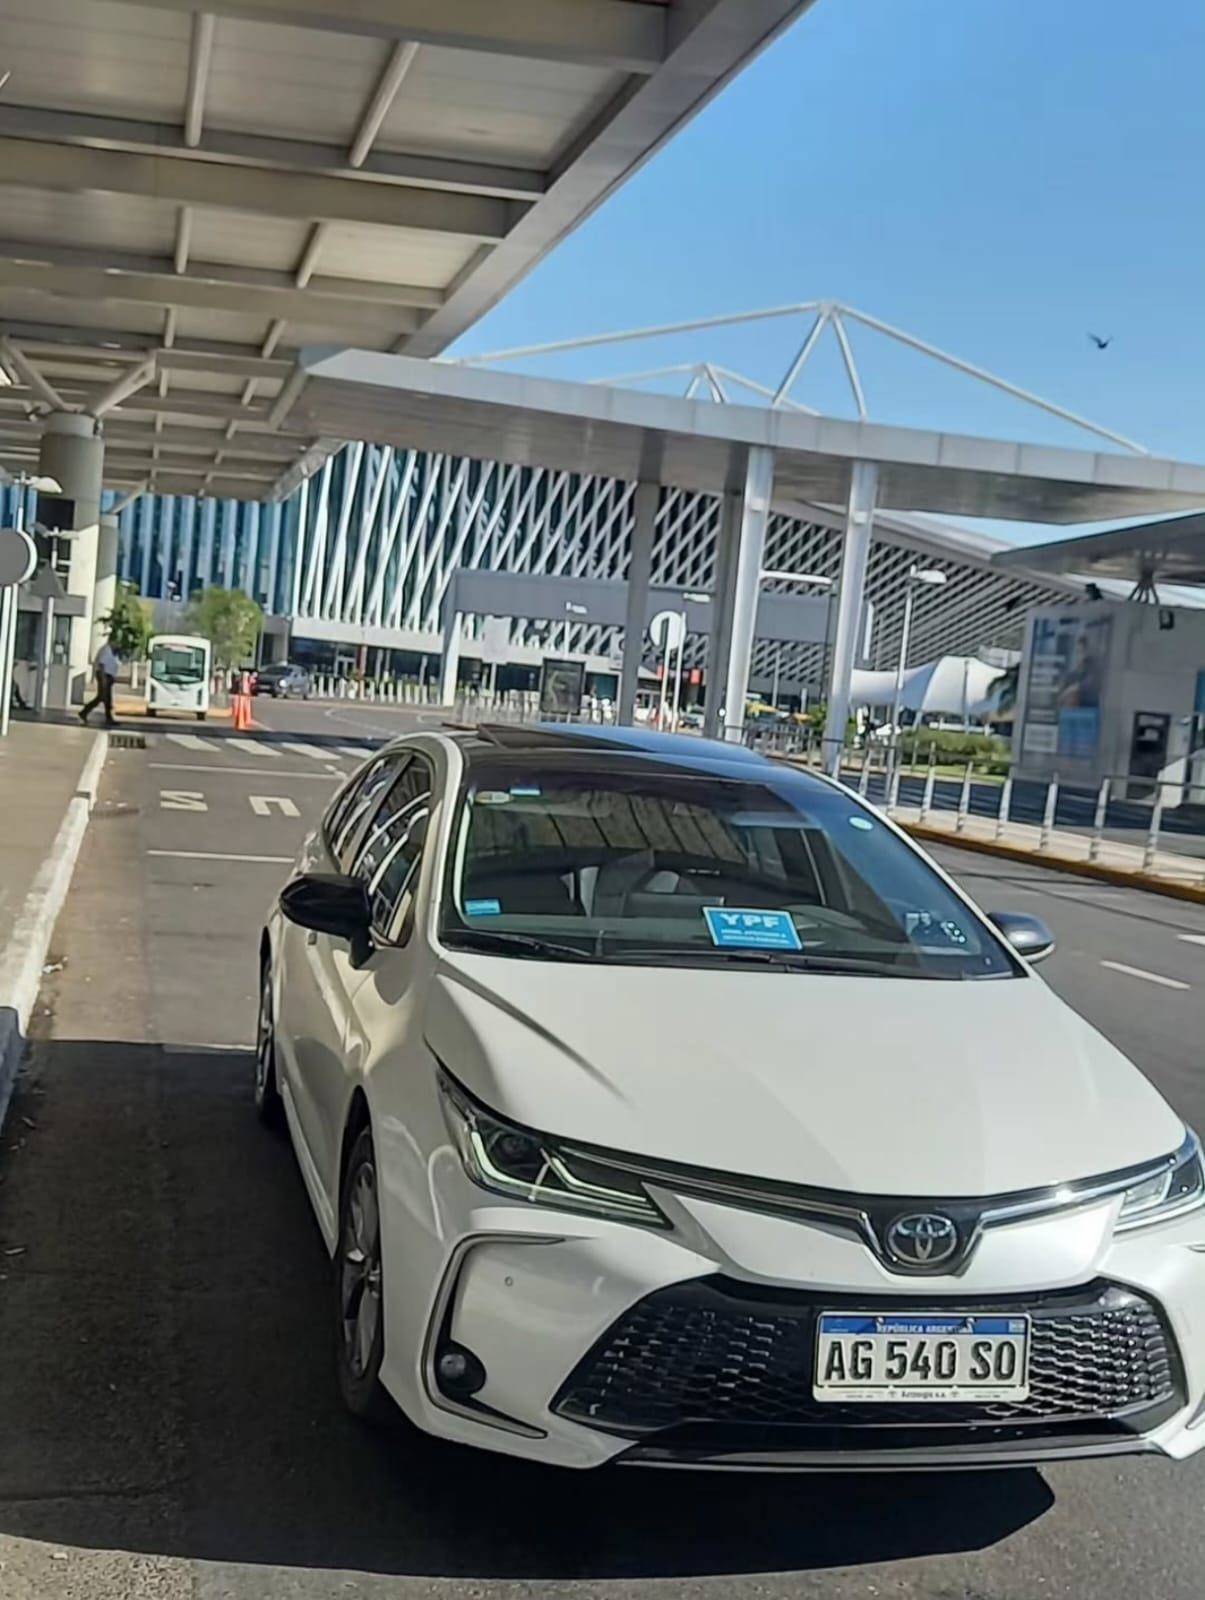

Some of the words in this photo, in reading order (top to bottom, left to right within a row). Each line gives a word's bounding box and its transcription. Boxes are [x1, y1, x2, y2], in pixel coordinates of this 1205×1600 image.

[720, 912, 780, 929] YPF
[824, 1340, 873, 1381] AG
[884, 1340, 957, 1381] 540
[969, 1340, 1017, 1381] SO
